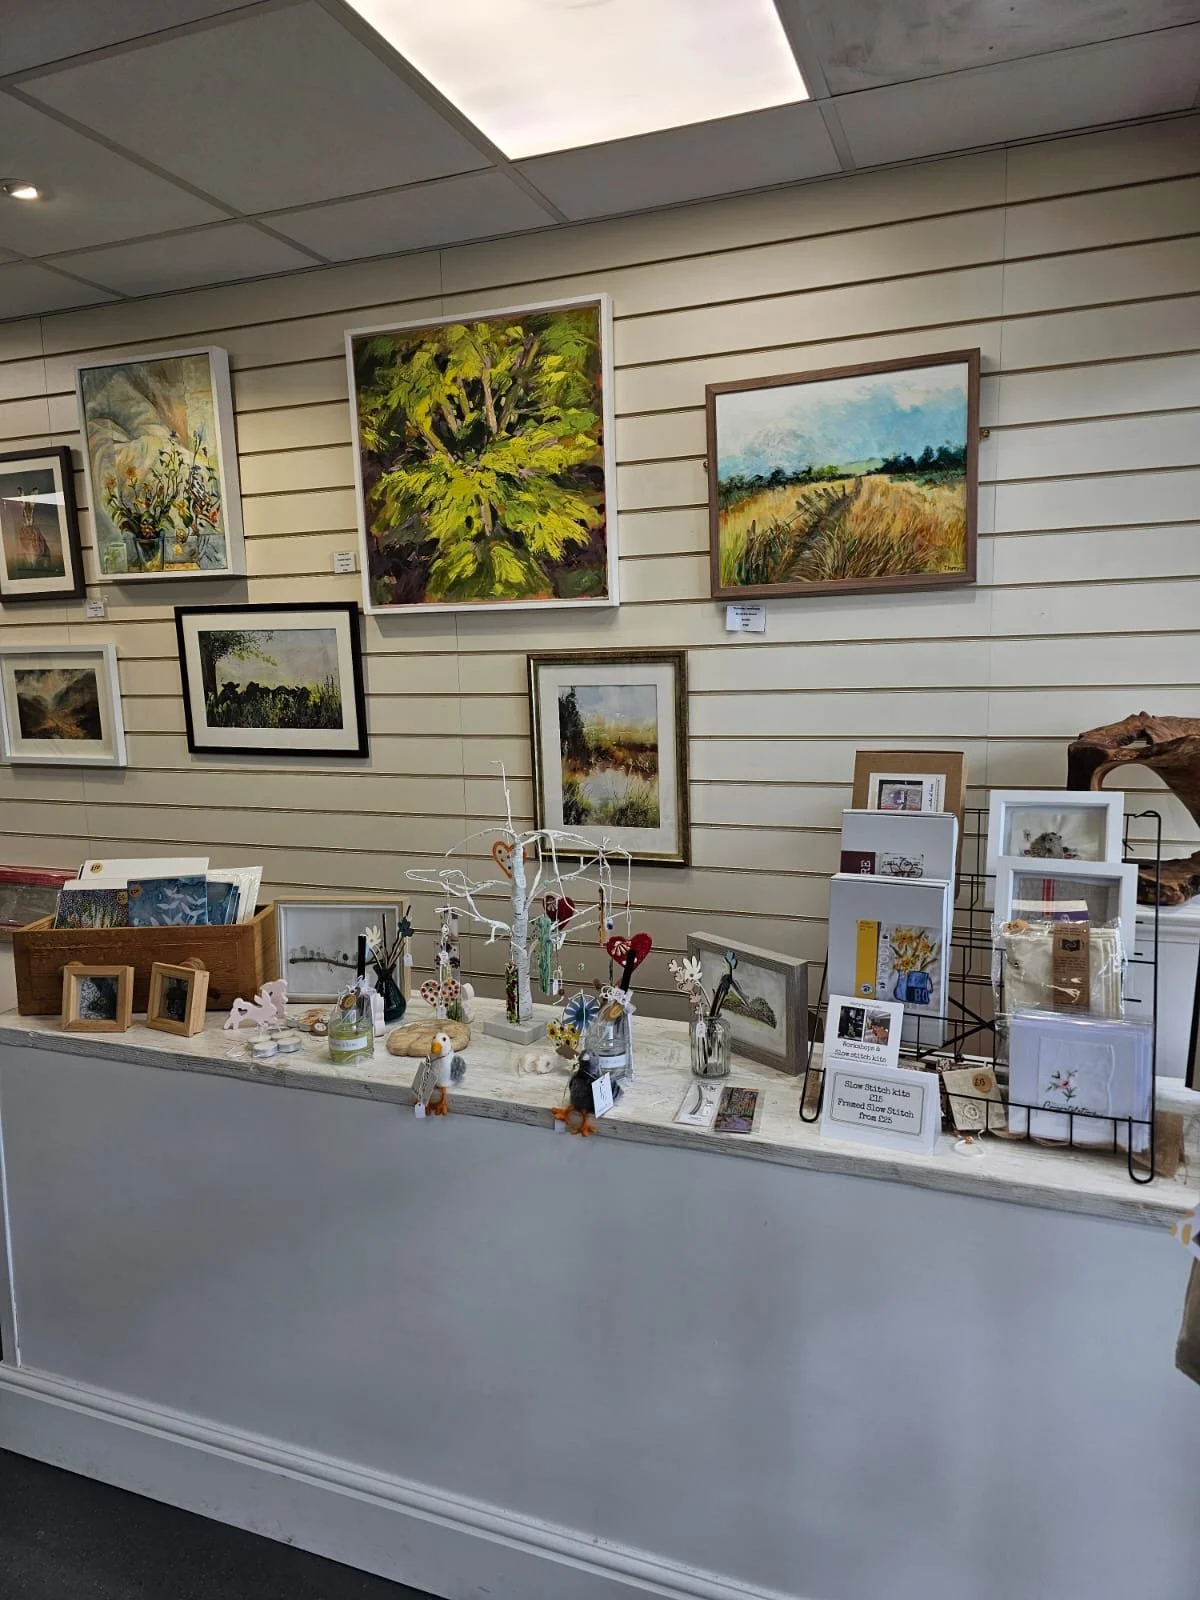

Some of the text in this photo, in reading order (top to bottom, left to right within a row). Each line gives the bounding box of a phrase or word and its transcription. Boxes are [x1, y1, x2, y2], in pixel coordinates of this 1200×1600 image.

[842, 1041, 874, 1052] Workshops
[834, 1049, 850, 1057] Slow
[871, 1055, 887, 1063] kits
[844, 1080, 911, 1098] Slow Stitch kits
[868, 1093, 884, 1103] £15
[837, 1098, 914, 1119] Framed Slow Stitch
[858, 1111, 893, 1124] from £25
